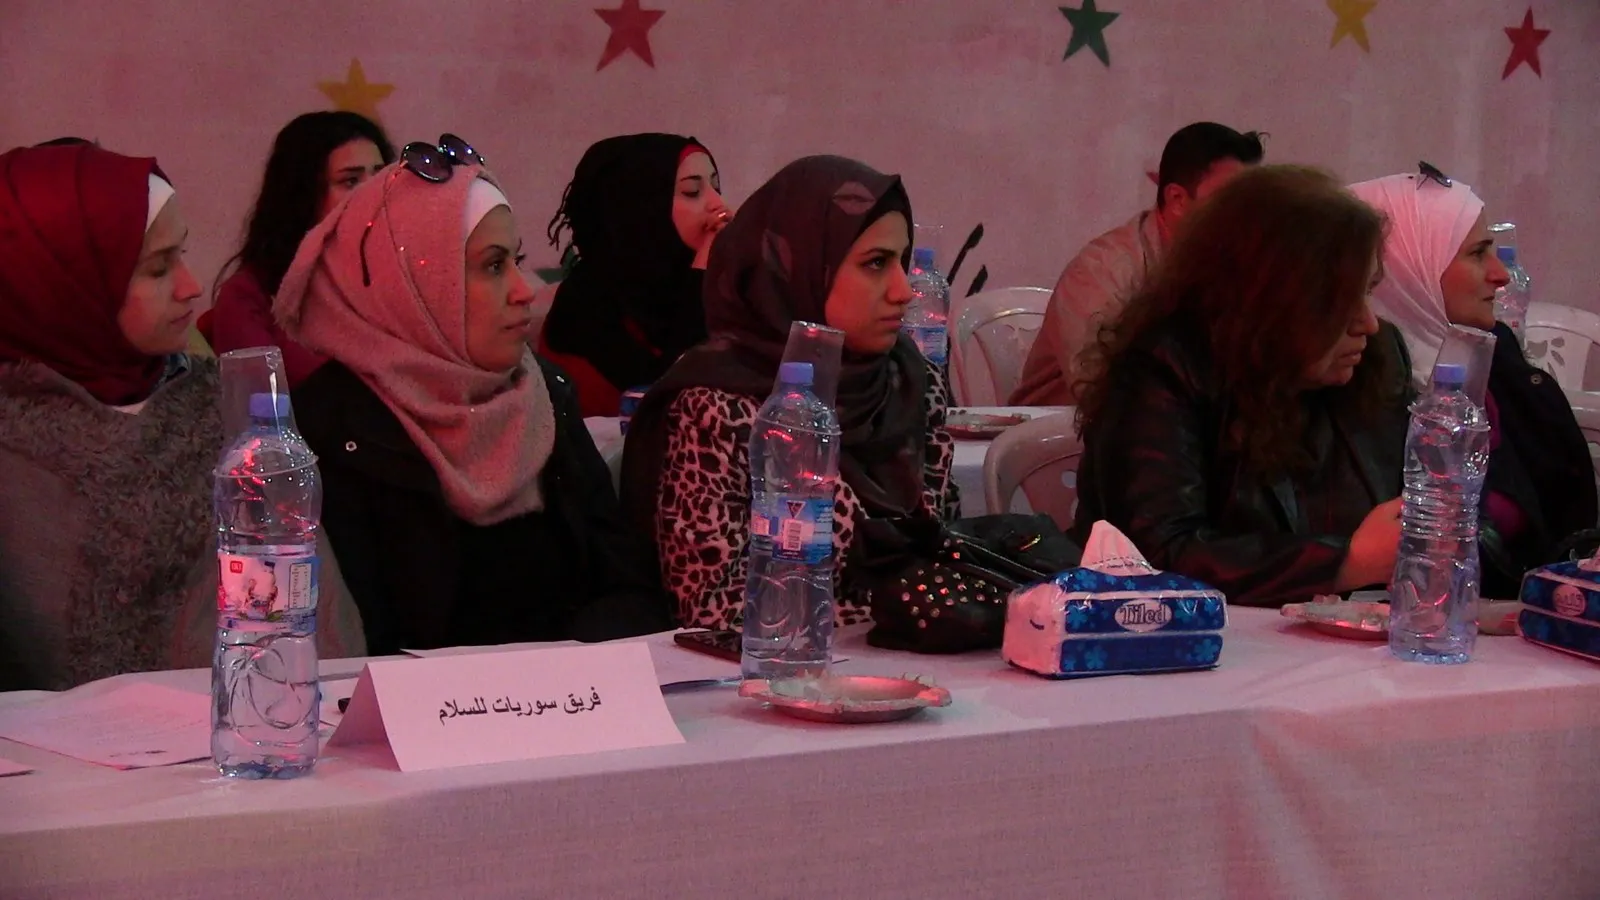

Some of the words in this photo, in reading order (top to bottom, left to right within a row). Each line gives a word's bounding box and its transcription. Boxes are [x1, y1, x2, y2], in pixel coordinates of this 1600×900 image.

[1120, 603, 1166, 625] Tiled
[438, 697, 488, 726] للسلام
[492, 696, 558, 717] سوريات
[563, 686, 602, 714] فريق
